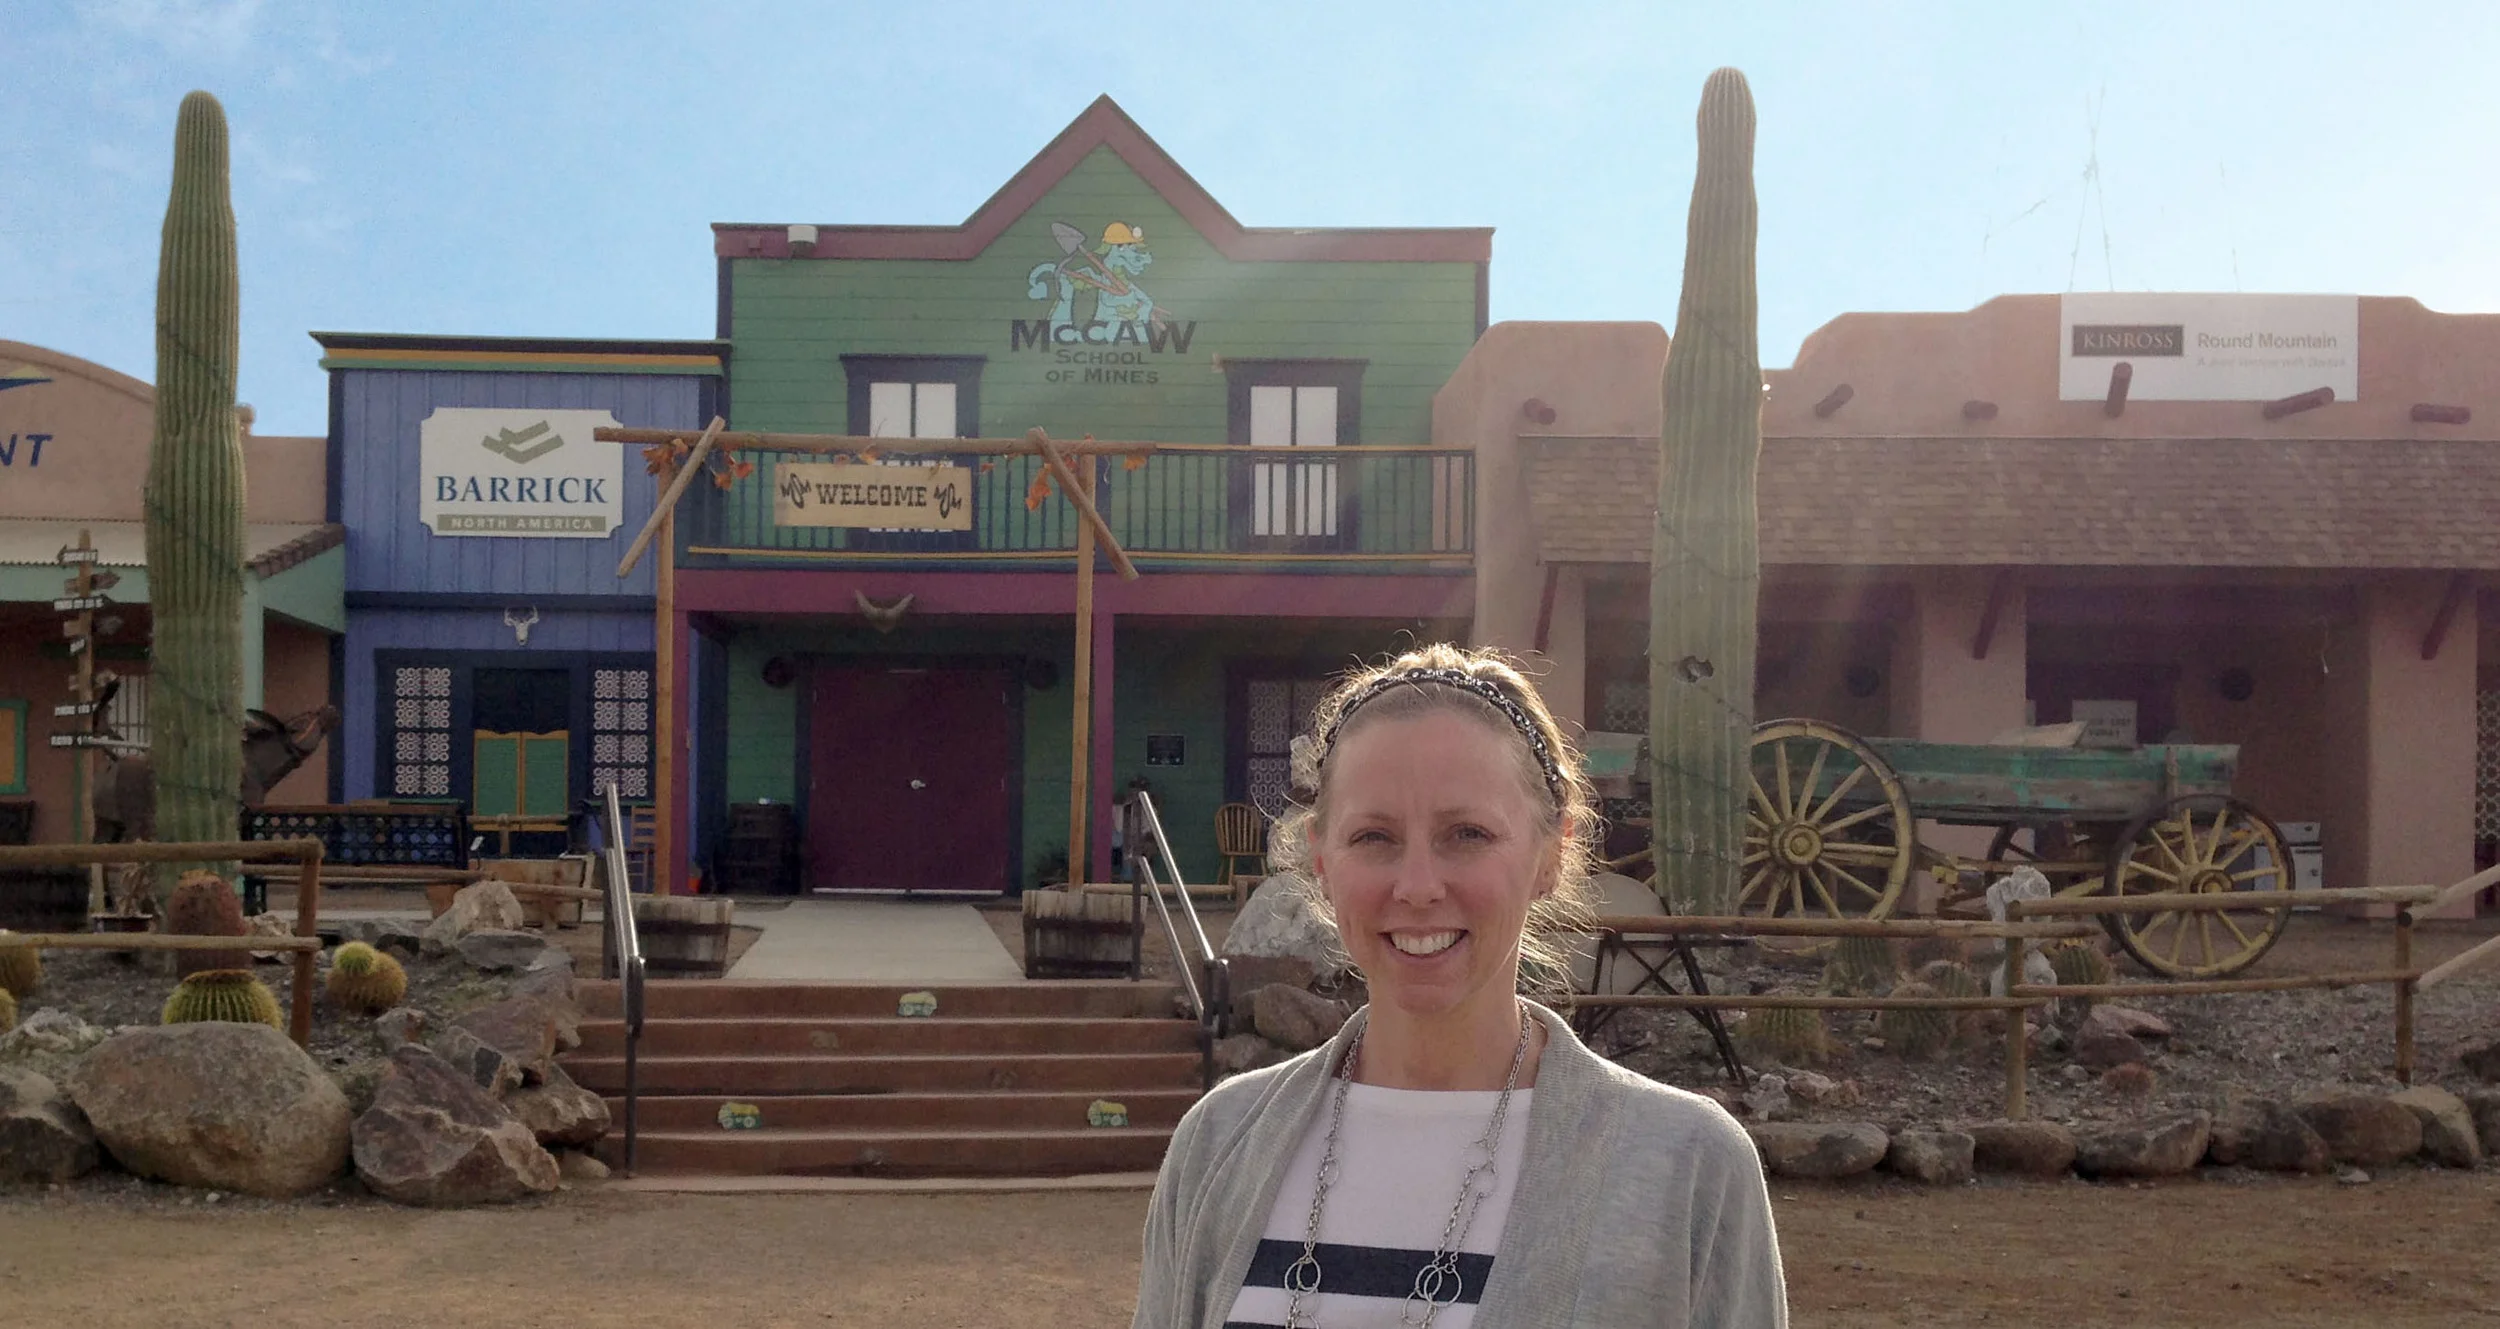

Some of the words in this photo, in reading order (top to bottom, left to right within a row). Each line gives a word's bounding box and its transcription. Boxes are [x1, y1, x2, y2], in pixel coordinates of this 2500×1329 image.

[2082, 331, 2174, 349] KINROSS
[2197, 332, 2253, 349] Round
[2258, 332, 2338, 349] Mountain
[1055, 349, 1150, 365] SCHOOL
[1045, 369, 1076, 383] OF
[1084, 367, 1160, 385] MINES
[435, 475, 608, 504] BARRICK
[815, 483, 928, 507] WELCOME
[451, 516, 508, 530] NORTH
[516, 517, 594, 531] AMERICA
